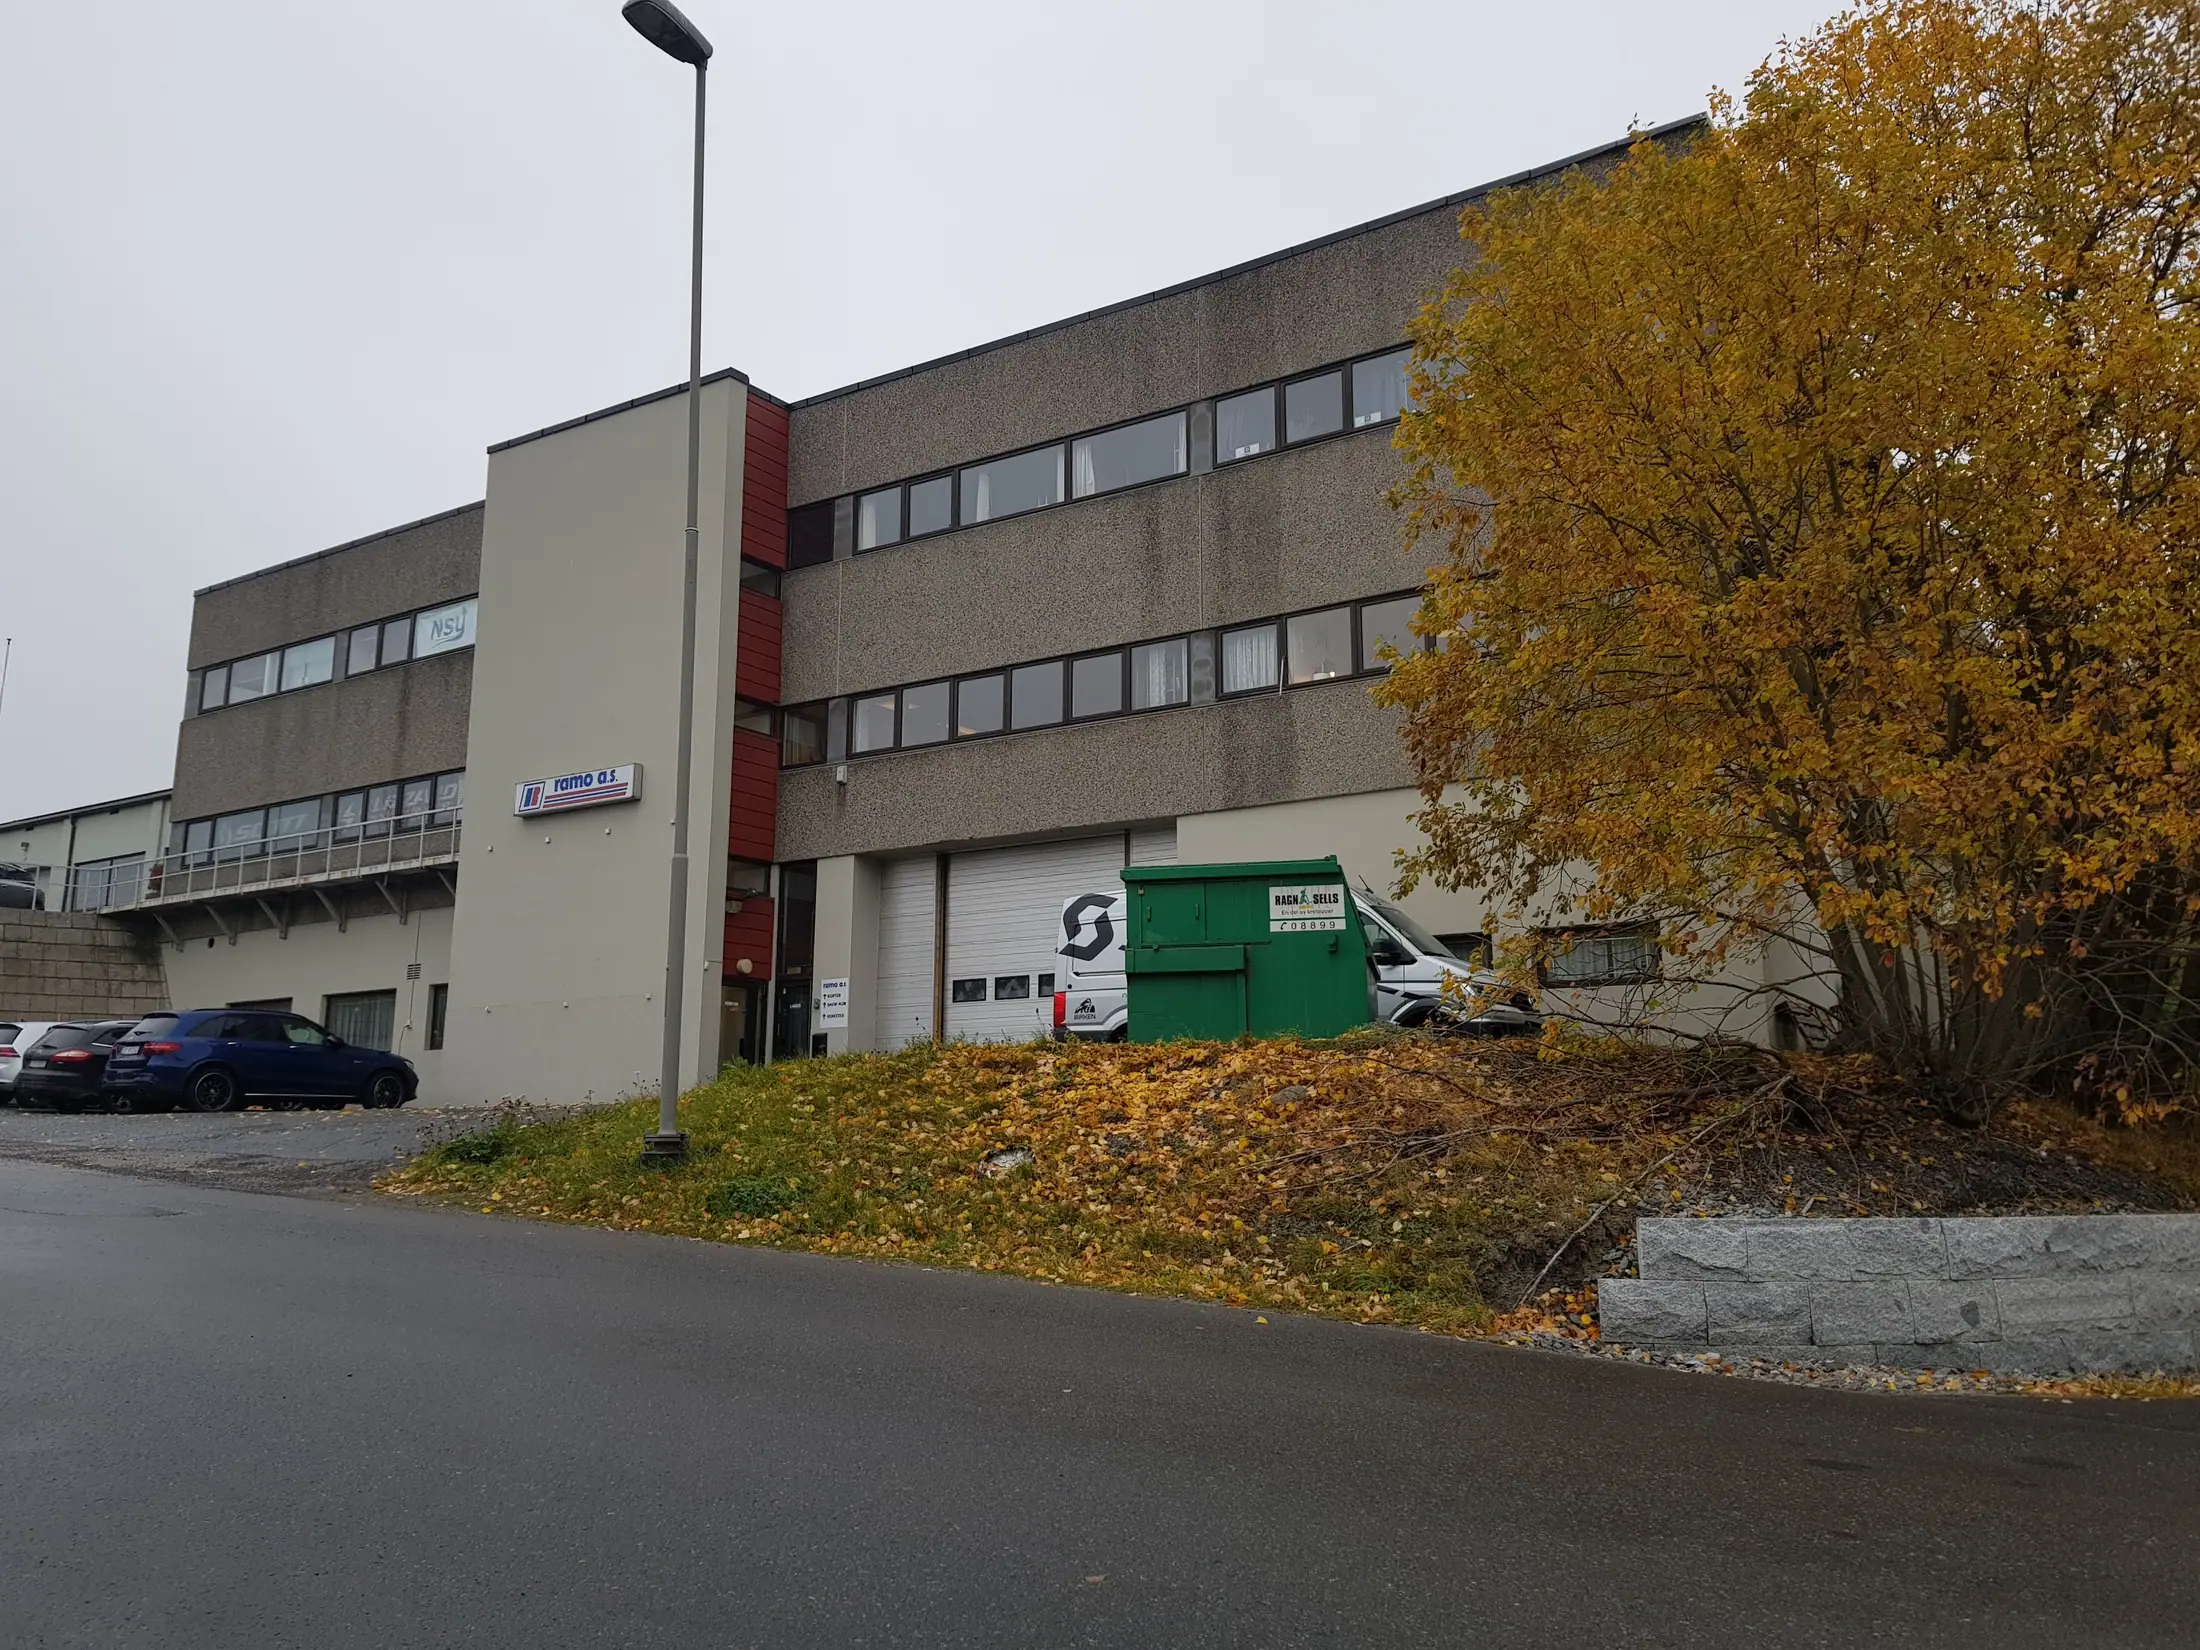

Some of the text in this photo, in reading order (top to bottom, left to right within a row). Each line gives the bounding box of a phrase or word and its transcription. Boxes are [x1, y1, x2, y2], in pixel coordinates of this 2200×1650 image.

[554, 773, 594, 792] ramo
[1275, 893, 1339, 905] RAGN SELLS
[1291, 921, 1336, 930] 08899
